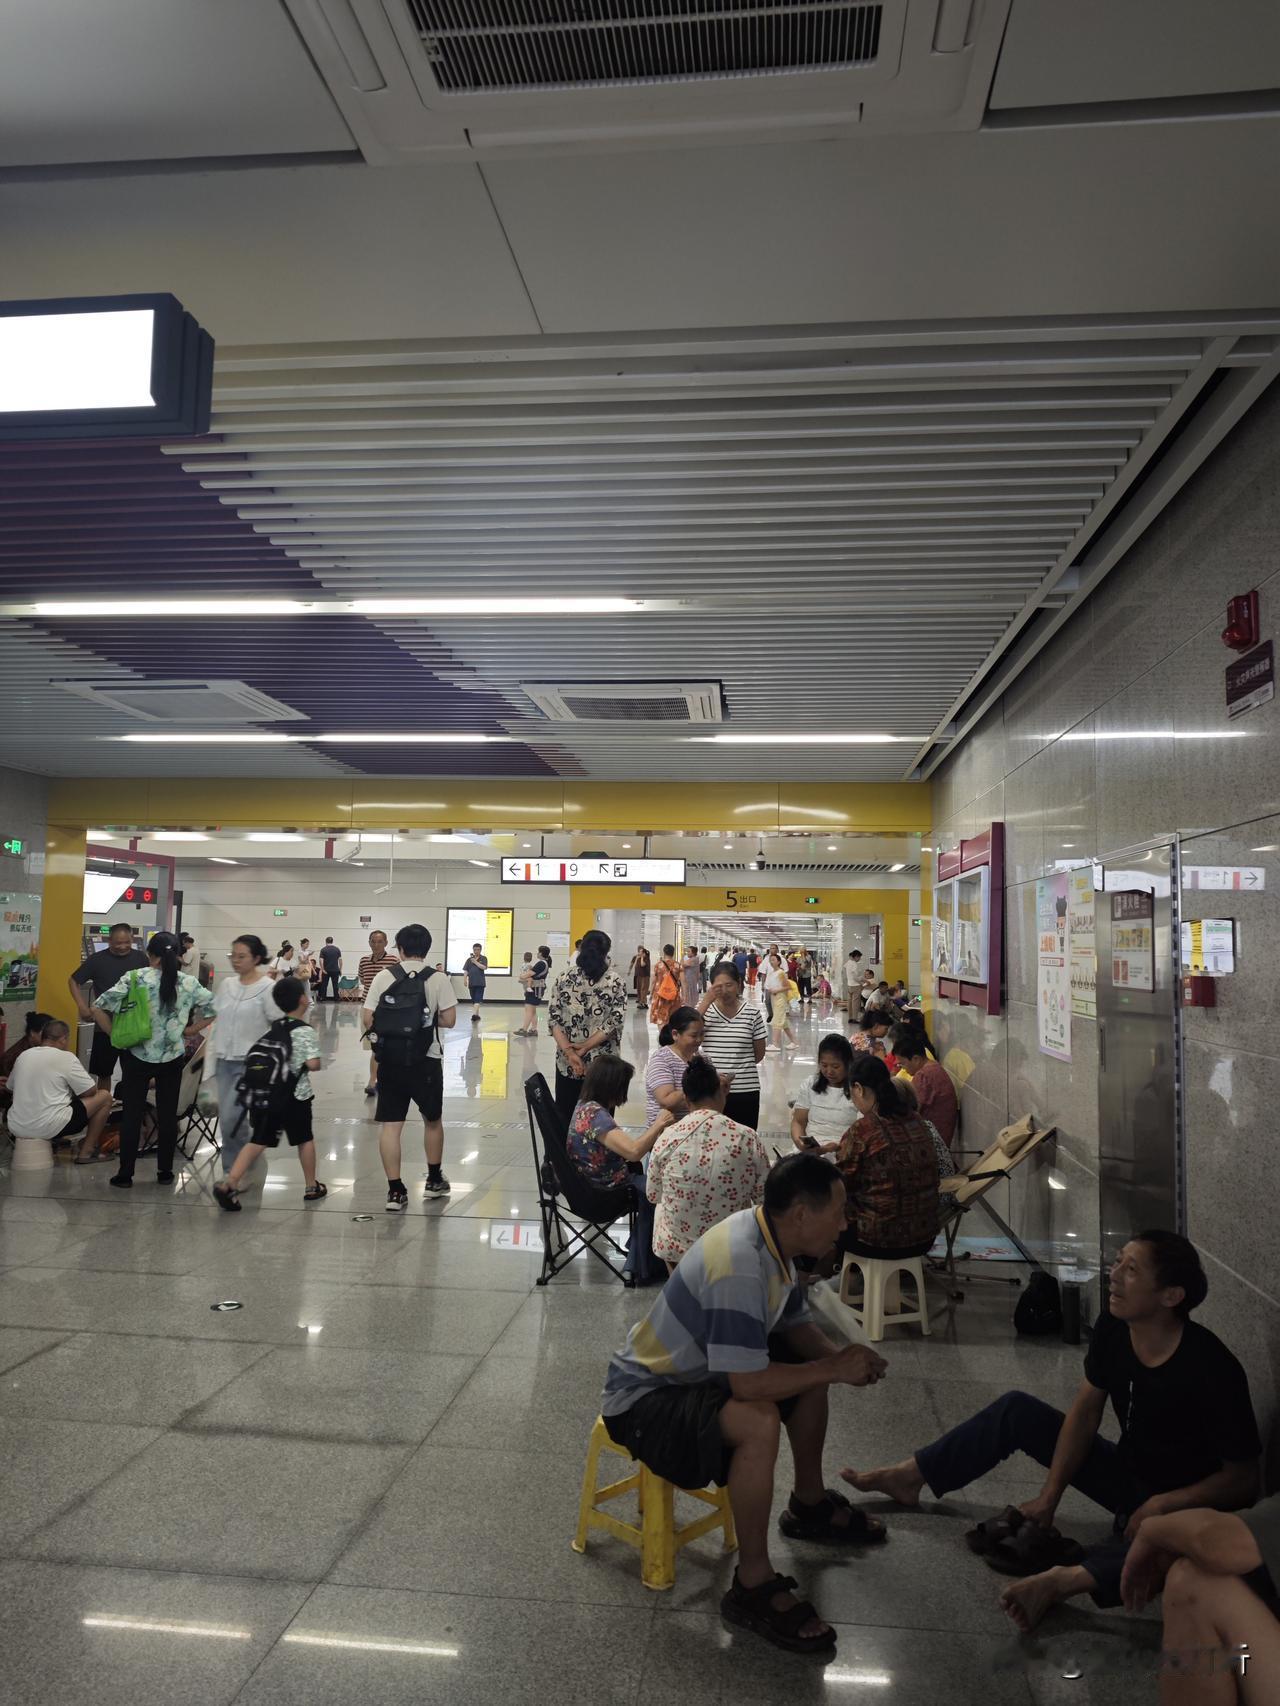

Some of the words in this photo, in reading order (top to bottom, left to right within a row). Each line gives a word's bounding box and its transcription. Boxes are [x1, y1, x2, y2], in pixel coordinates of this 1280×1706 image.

[536, 863, 540, 876] 1
[569, 863, 578, 877] 9
[726, 890, 738, 908] 5
[740, 895, 757, 904] 出口
